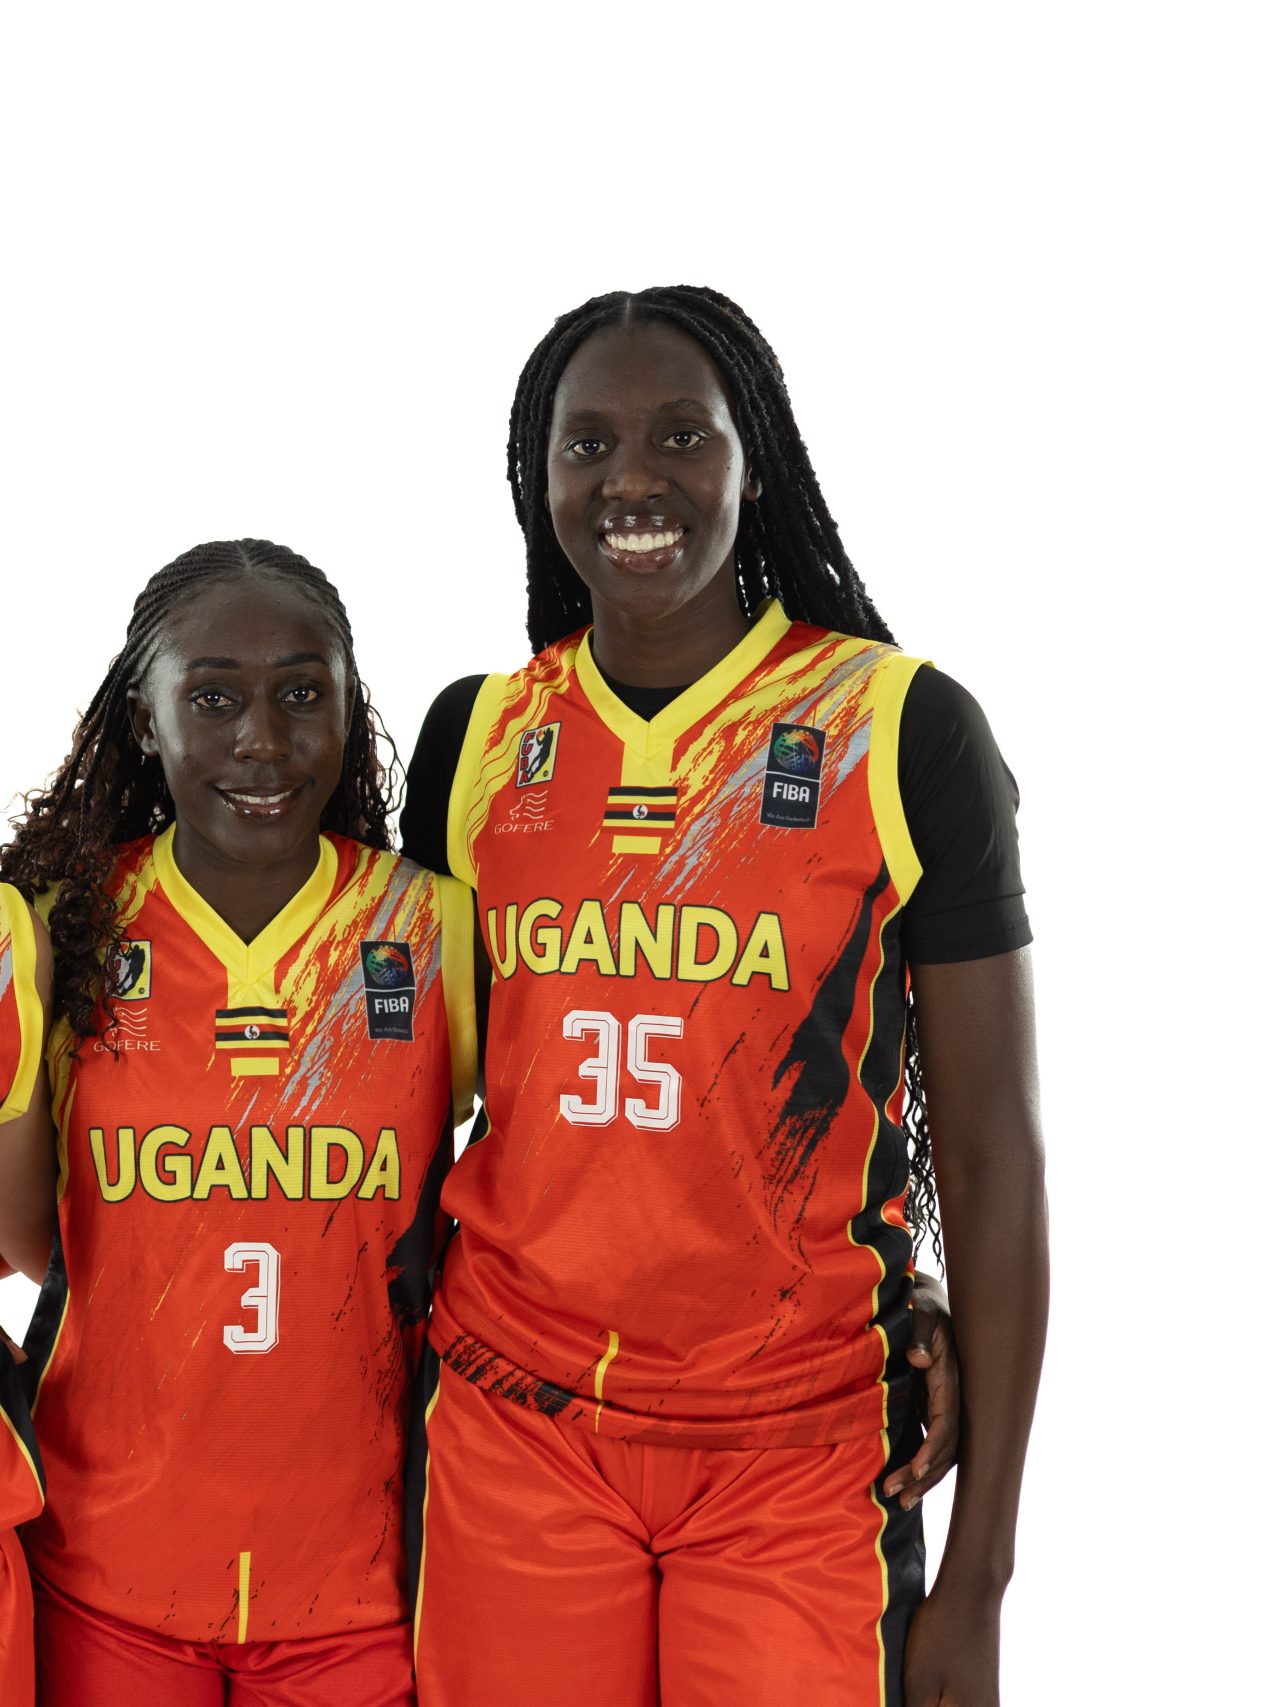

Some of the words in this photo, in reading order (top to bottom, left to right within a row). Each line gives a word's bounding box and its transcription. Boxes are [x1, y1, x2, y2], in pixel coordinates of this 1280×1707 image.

[518, 731, 537, 785] FUBA
[772, 781, 810, 803] FIBA
[494, 820, 555, 835] GOFERE
[486, 897, 791, 992] UGANDA
[374, 996, 409, 1014] FIBA
[93, 1040, 161, 1053] GOFERE
[559, 1009, 685, 1133] 35
[88, 1124, 402, 1202] UGANDA
[222, 1241, 281, 1354] 3
